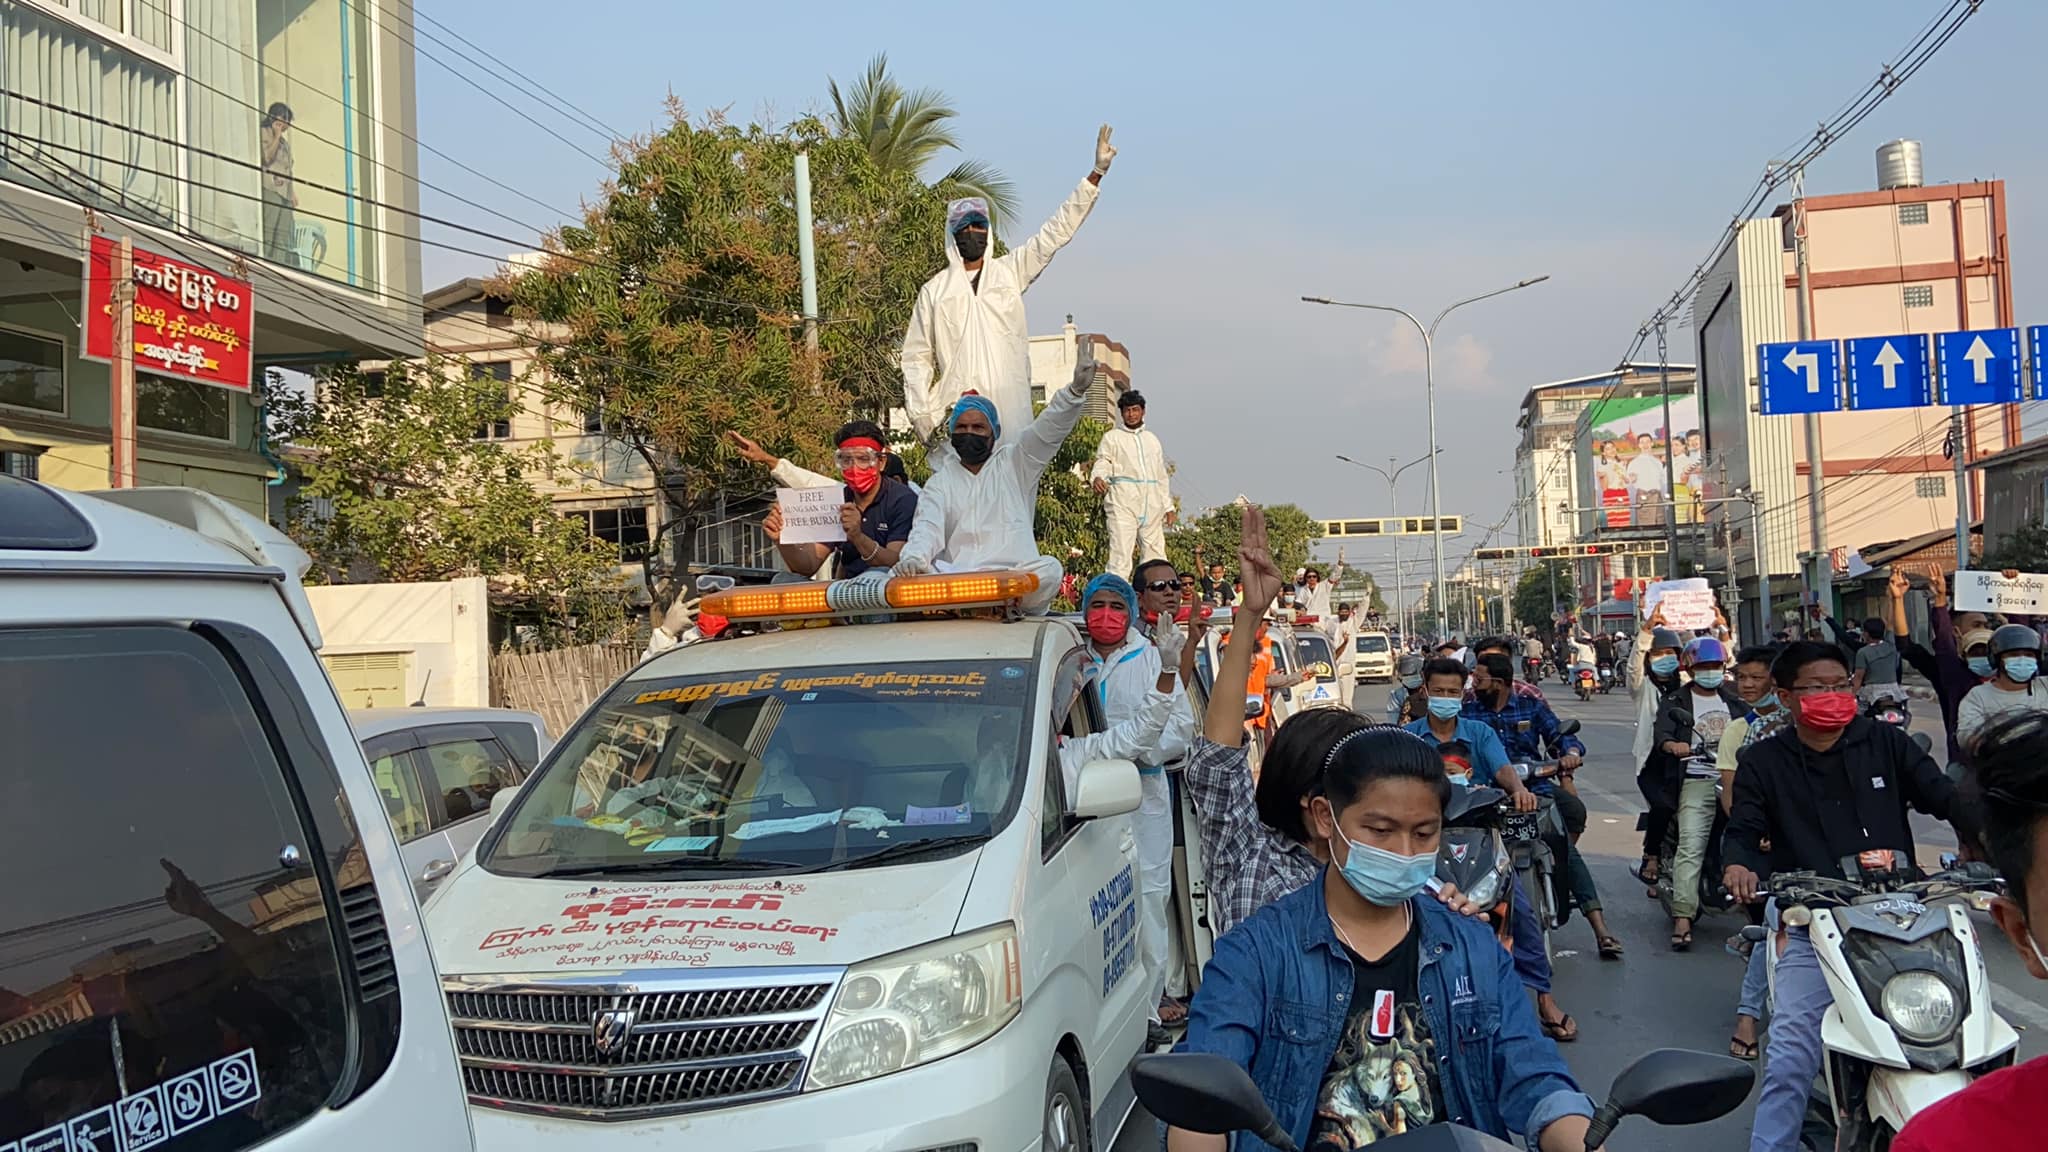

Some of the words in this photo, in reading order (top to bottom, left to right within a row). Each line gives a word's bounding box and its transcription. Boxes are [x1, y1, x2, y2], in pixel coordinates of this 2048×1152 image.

[799, 491, 824, 502] FREE
[785, 517, 808, 528] FREE
[128, 1128, 163, 1151] Service
